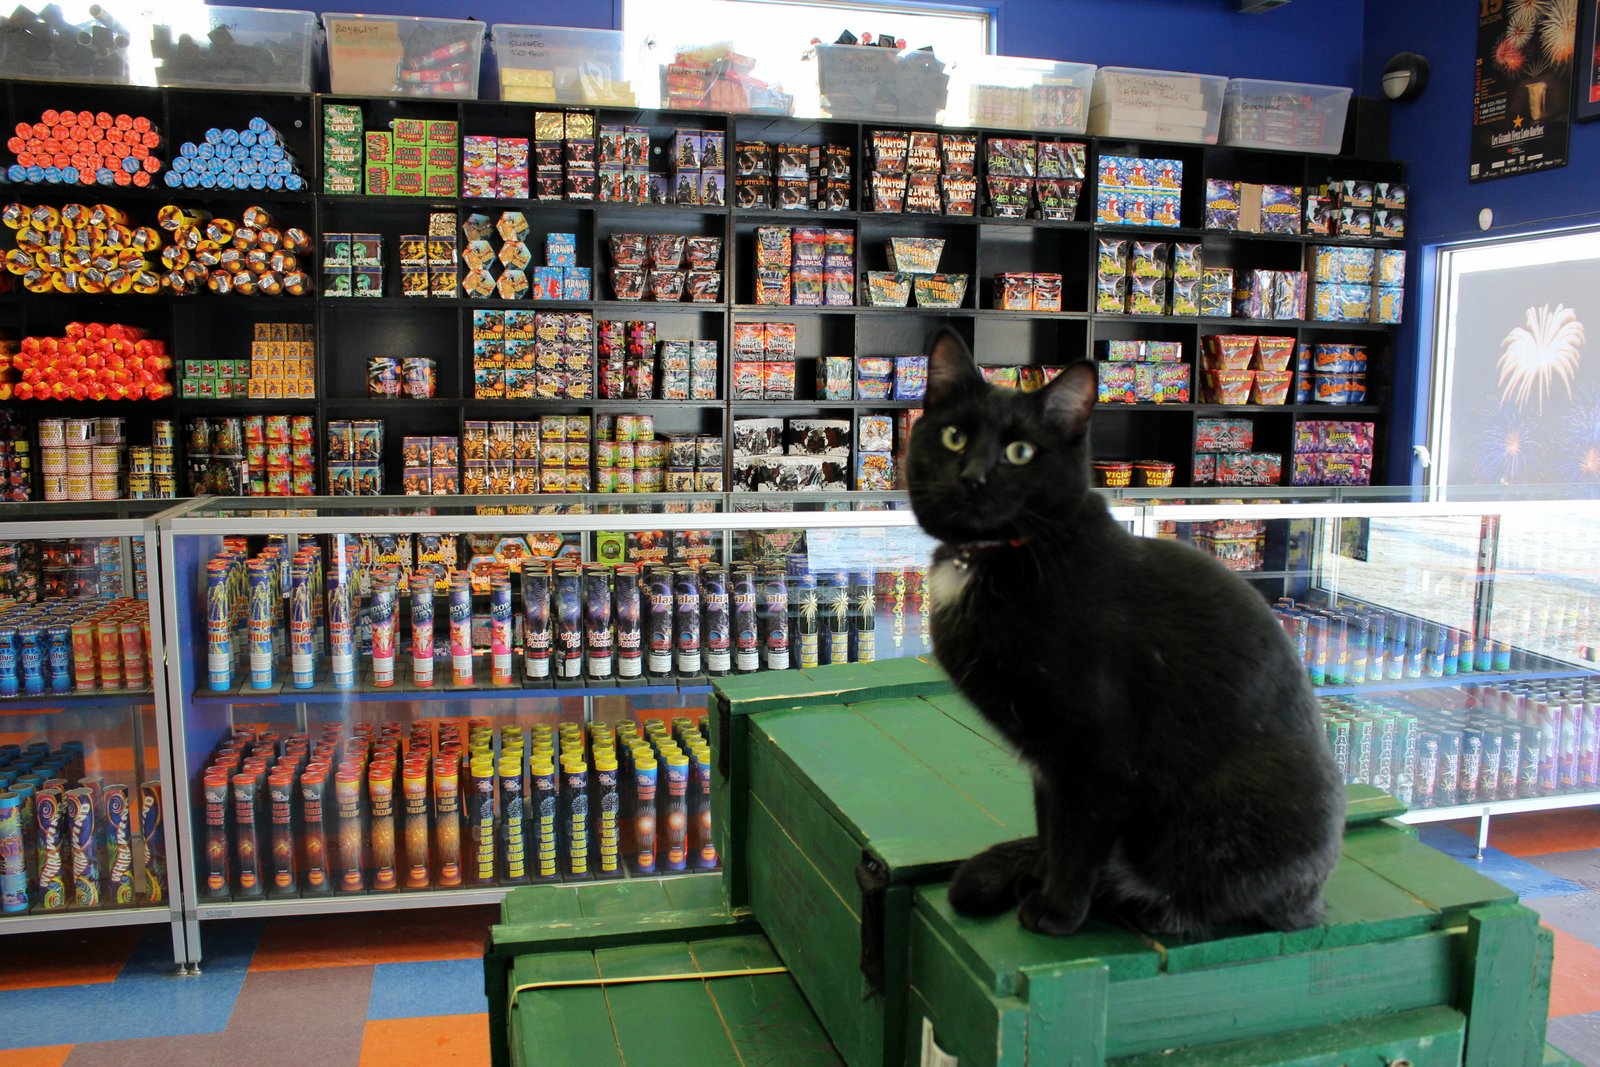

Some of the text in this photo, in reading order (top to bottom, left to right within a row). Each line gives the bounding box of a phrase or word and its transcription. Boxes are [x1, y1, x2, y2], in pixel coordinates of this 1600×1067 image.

[874, 138, 907, 148] PHANTOM
[943, 141, 976, 152] PHANTOM
[908, 158, 941, 168] PHANTOM
[873, 178, 906, 189] PHANTOM
[943, 181, 976, 191] PHANTOM
[907, 197, 941, 206] PHANTOM
[550, 245, 573, 253] PIRANHA
[565, 280, 589, 288] PIRANHA
[1110, 388, 1125, 396] 100
[1163, 386, 1178, 394] 100
[1329, 432, 1350, 440] MAGIC
[532, 542, 558, 551] BANDITO
[471, 576, 490, 584] BANDI
